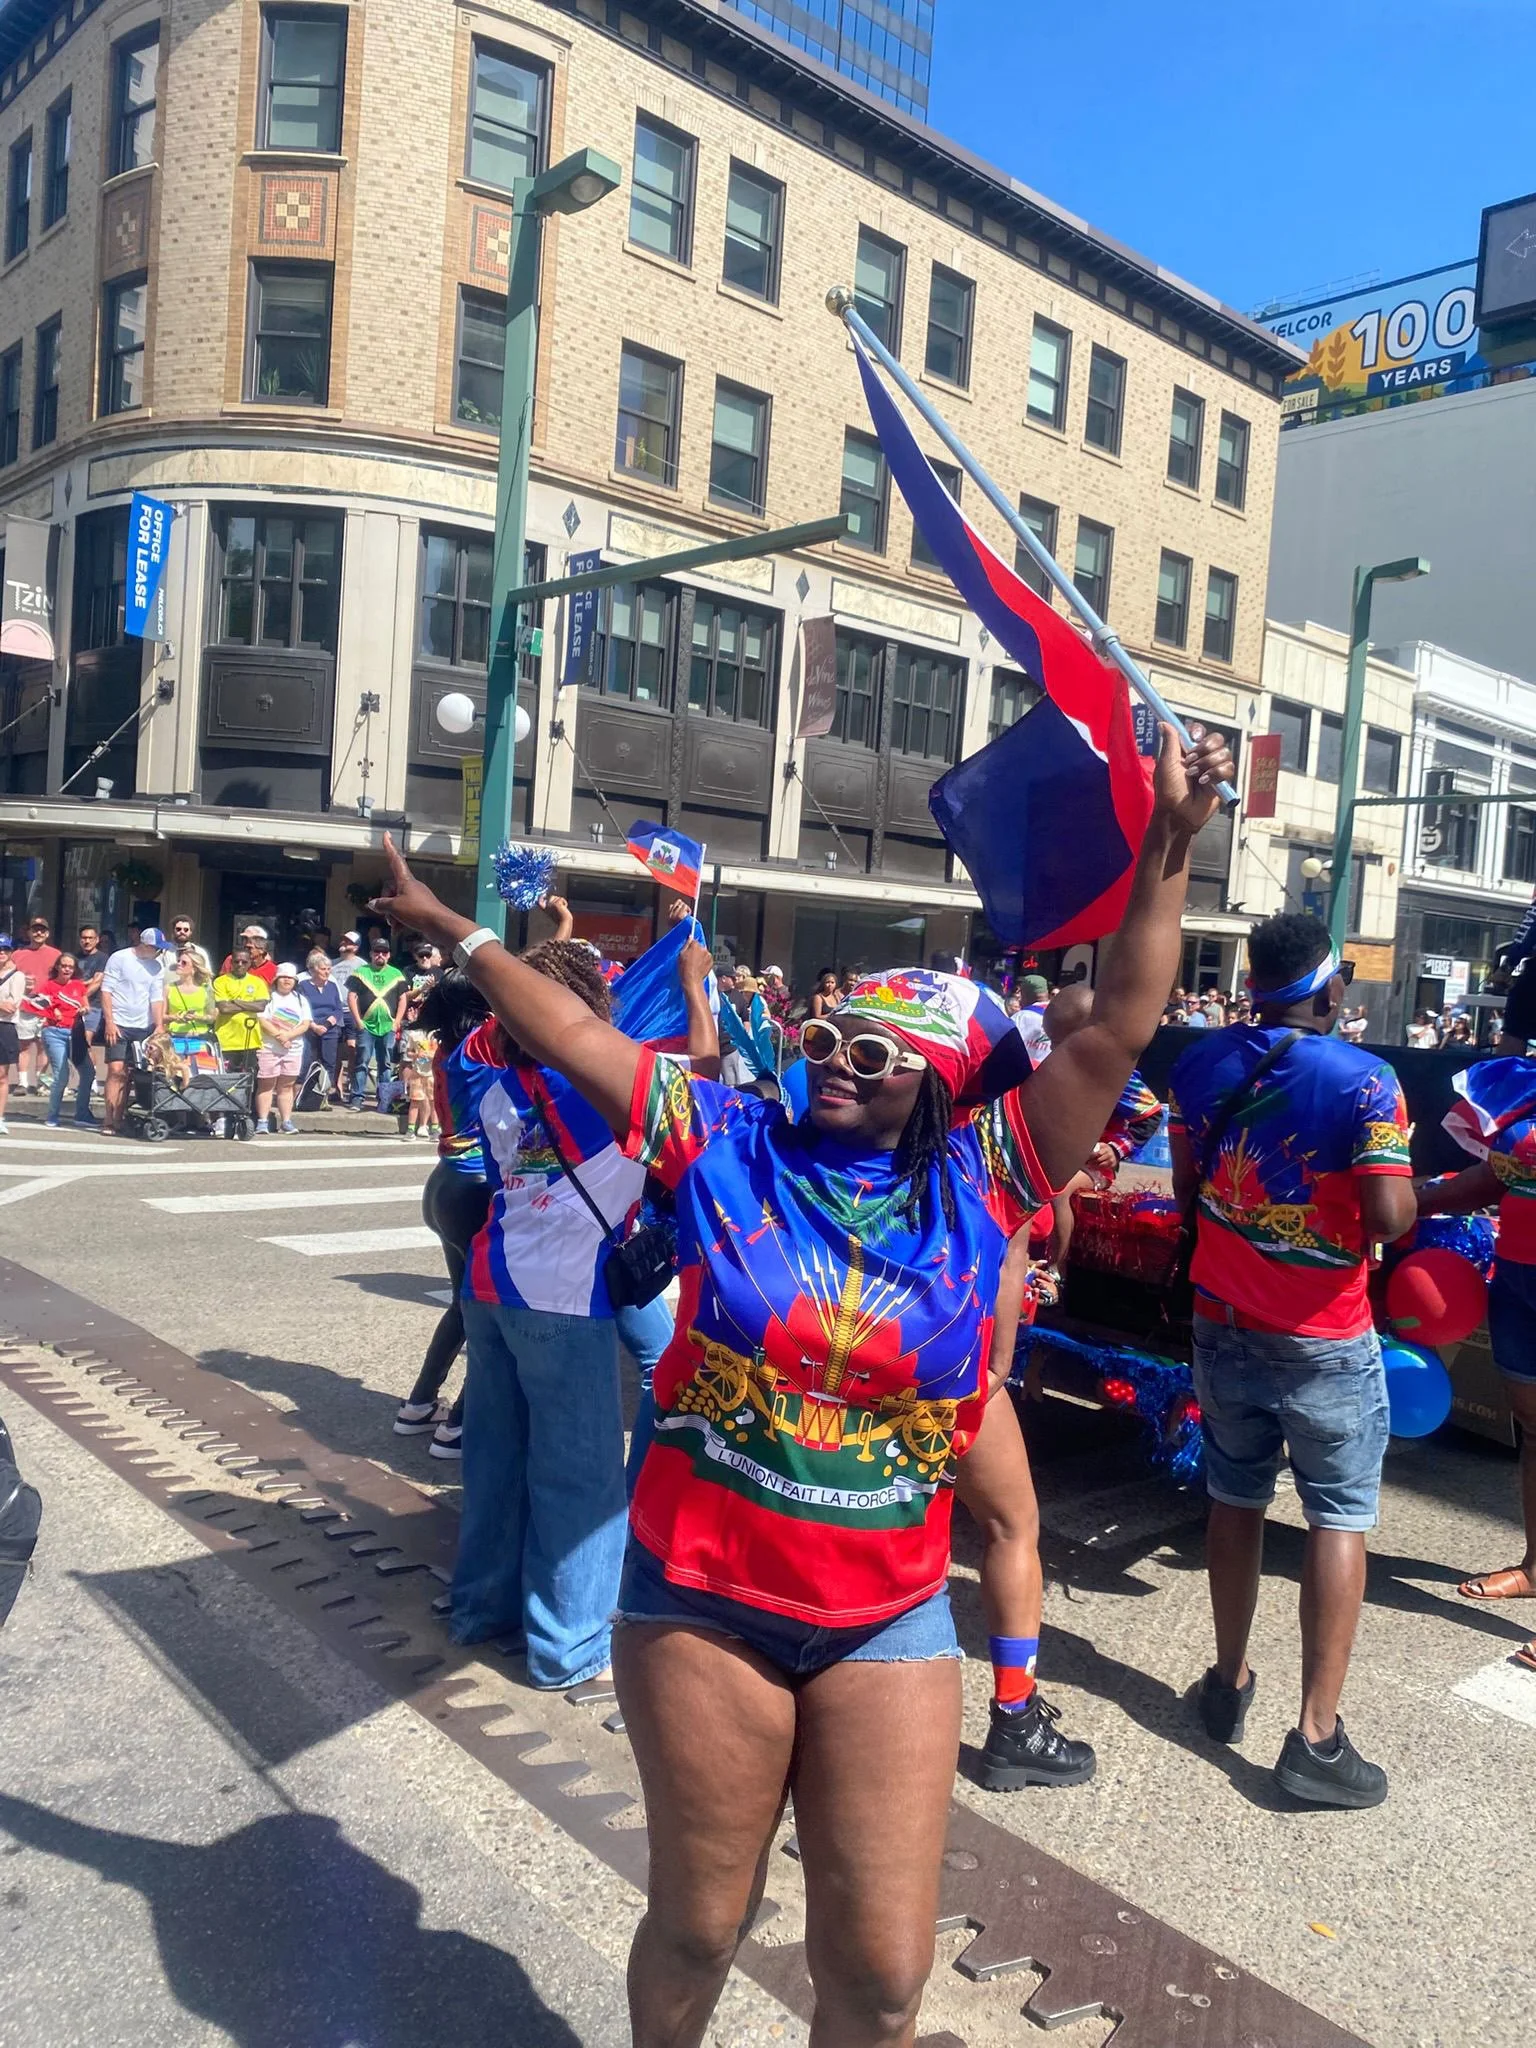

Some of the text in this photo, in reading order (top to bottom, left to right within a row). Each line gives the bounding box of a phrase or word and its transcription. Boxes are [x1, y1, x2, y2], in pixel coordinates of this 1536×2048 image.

[1351, 286, 1477, 370] 100
[1381, 358, 1452, 390] YEARS
[1283, 394, 1314, 412] FOR SALE
[135, 504, 152, 609] FOR LEASE
[151, 509, 164, 564] OFFICE
[572, 602, 583, 658] LEASE
[1136, 710, 1145, 735] FOR
[718, 1449, 896, 1508] L'UNION FAIT LA FORCE
